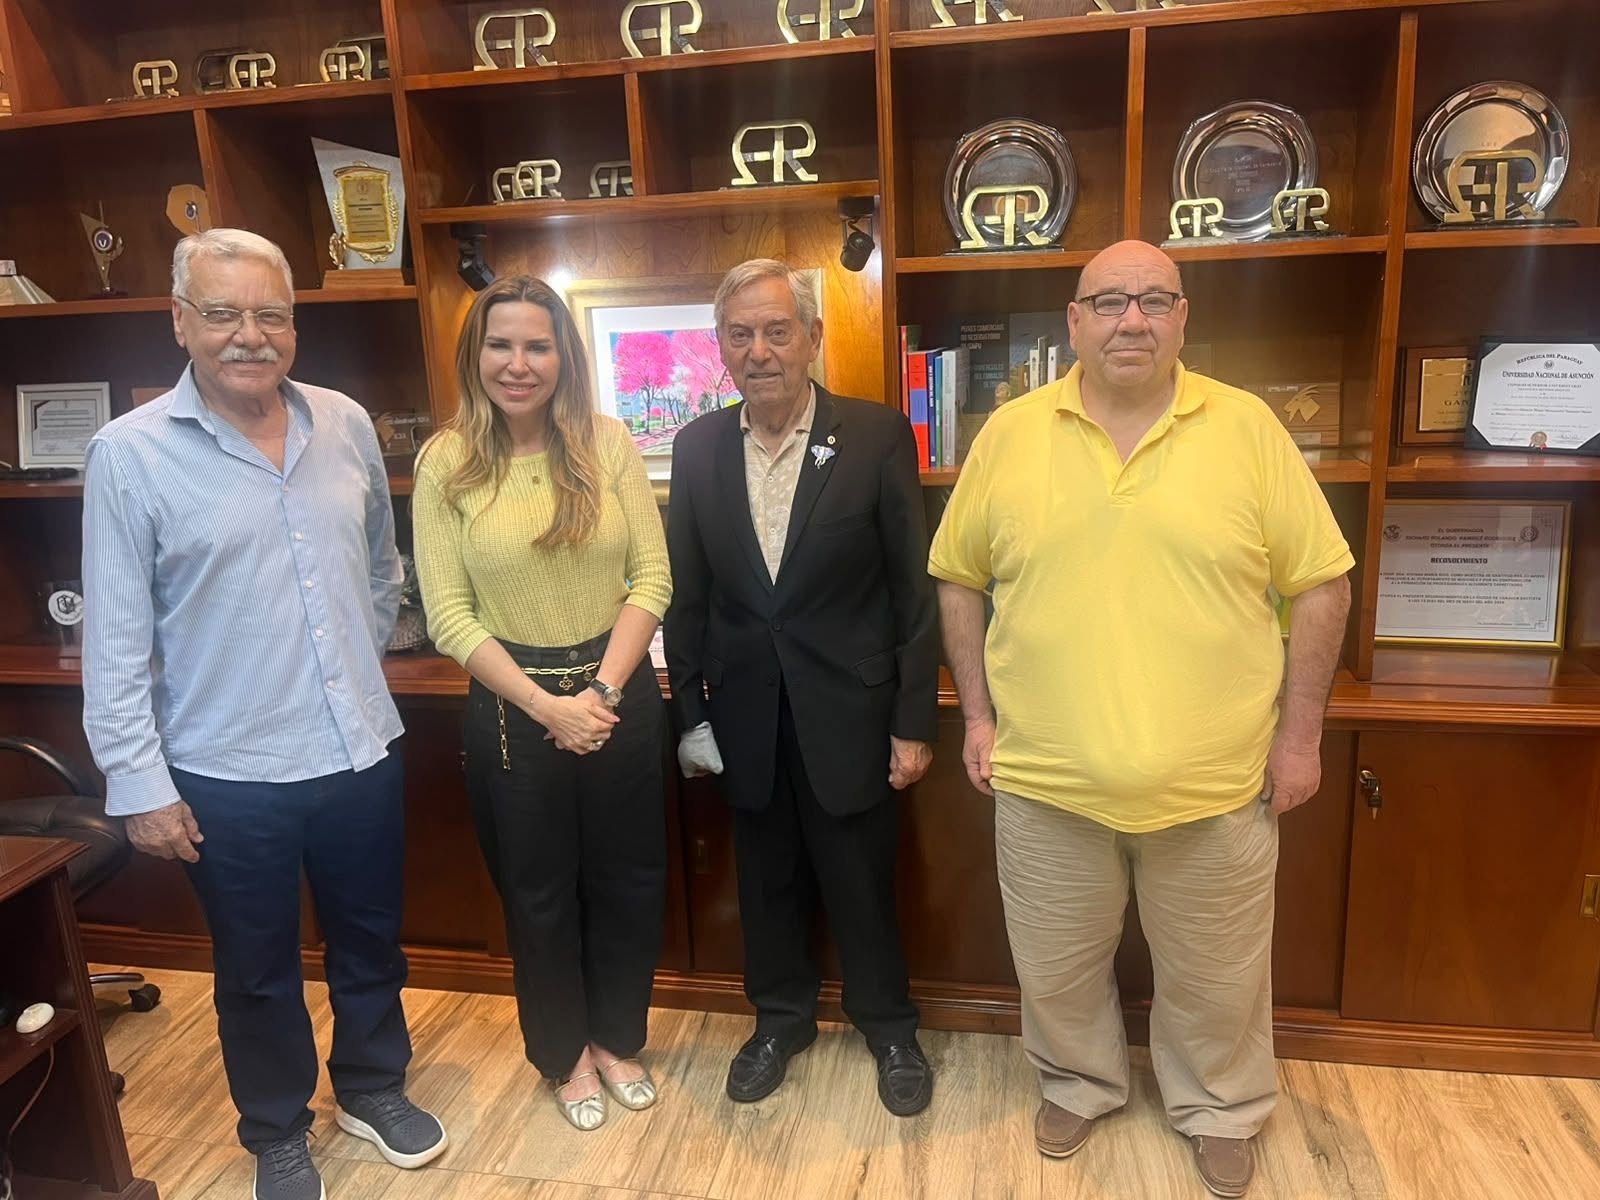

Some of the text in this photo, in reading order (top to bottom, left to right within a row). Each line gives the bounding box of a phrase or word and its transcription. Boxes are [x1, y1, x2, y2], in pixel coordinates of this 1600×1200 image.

[1556, 353, 1584, 365] PARAGUAY
[1535, 371, 1561, 379] NACIONAL
[1430, 556, 1489, 565] RECONOCIMIENTO
